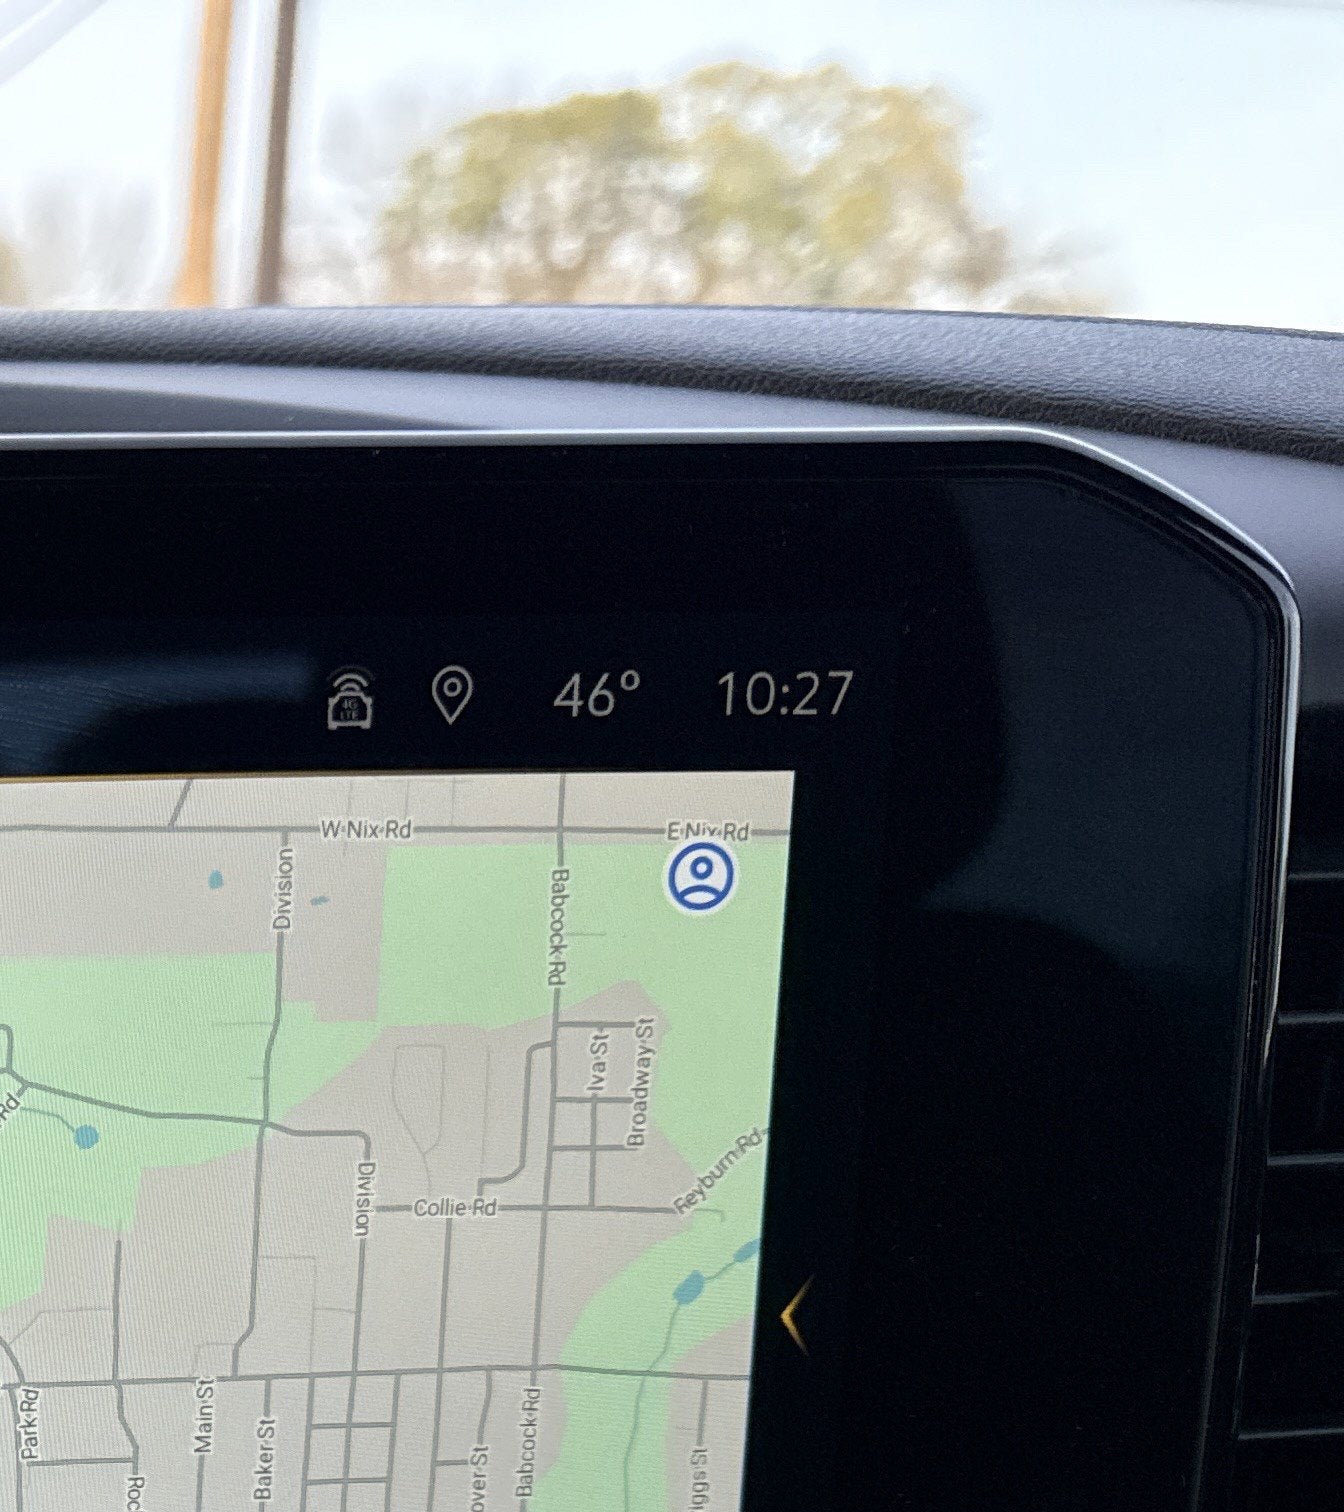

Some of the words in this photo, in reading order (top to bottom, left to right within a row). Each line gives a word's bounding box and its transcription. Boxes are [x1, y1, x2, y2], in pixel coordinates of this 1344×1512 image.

[553, 670, 641, 718] 46°
[717, 671, 854, 717] 10:27
[321, 821, 339, 839] W
[345, 820, 379, 839] Nix
[386, 820, 412, 839] Rd
[667, 821, 681, 841] E
[723, 822, 750, 842] Rd
[273, 848, 293, 930] Division
[549, 869, 570, 956] Babcock
[547, 961, 567, 986] Rd
[591, 1032, 610, 1055] St
[637, 1018, 656, 1041] St
[587, 1059, 605, 1092] Iva
[627, 1044, 655, 1147] Broadway
[674, 1150, 739, 1214] Reyburn
[735, 1127, 762, 1154] Rd
[354, 1162, 376, 1238] Division
[414, 1199, 466, 1217] Collie
[473, 1198, 497, 1217] Rd
[23, 1387, 40, 1409] Rd
[197, 1379, 215, 1399] St
[522, 1388, 541, 1412] Rd
[20, 1413, 40, 1460] Park
[194, 1404, 214, 1453] Main
[257, 1419, 276, 1439] St
[471, 1446, 490, 1465] St
[516, 1419, 538, 1497] Babcock
[690, 1448, 708, 1469] St
[253, 1445, 274, 1501] Baker
